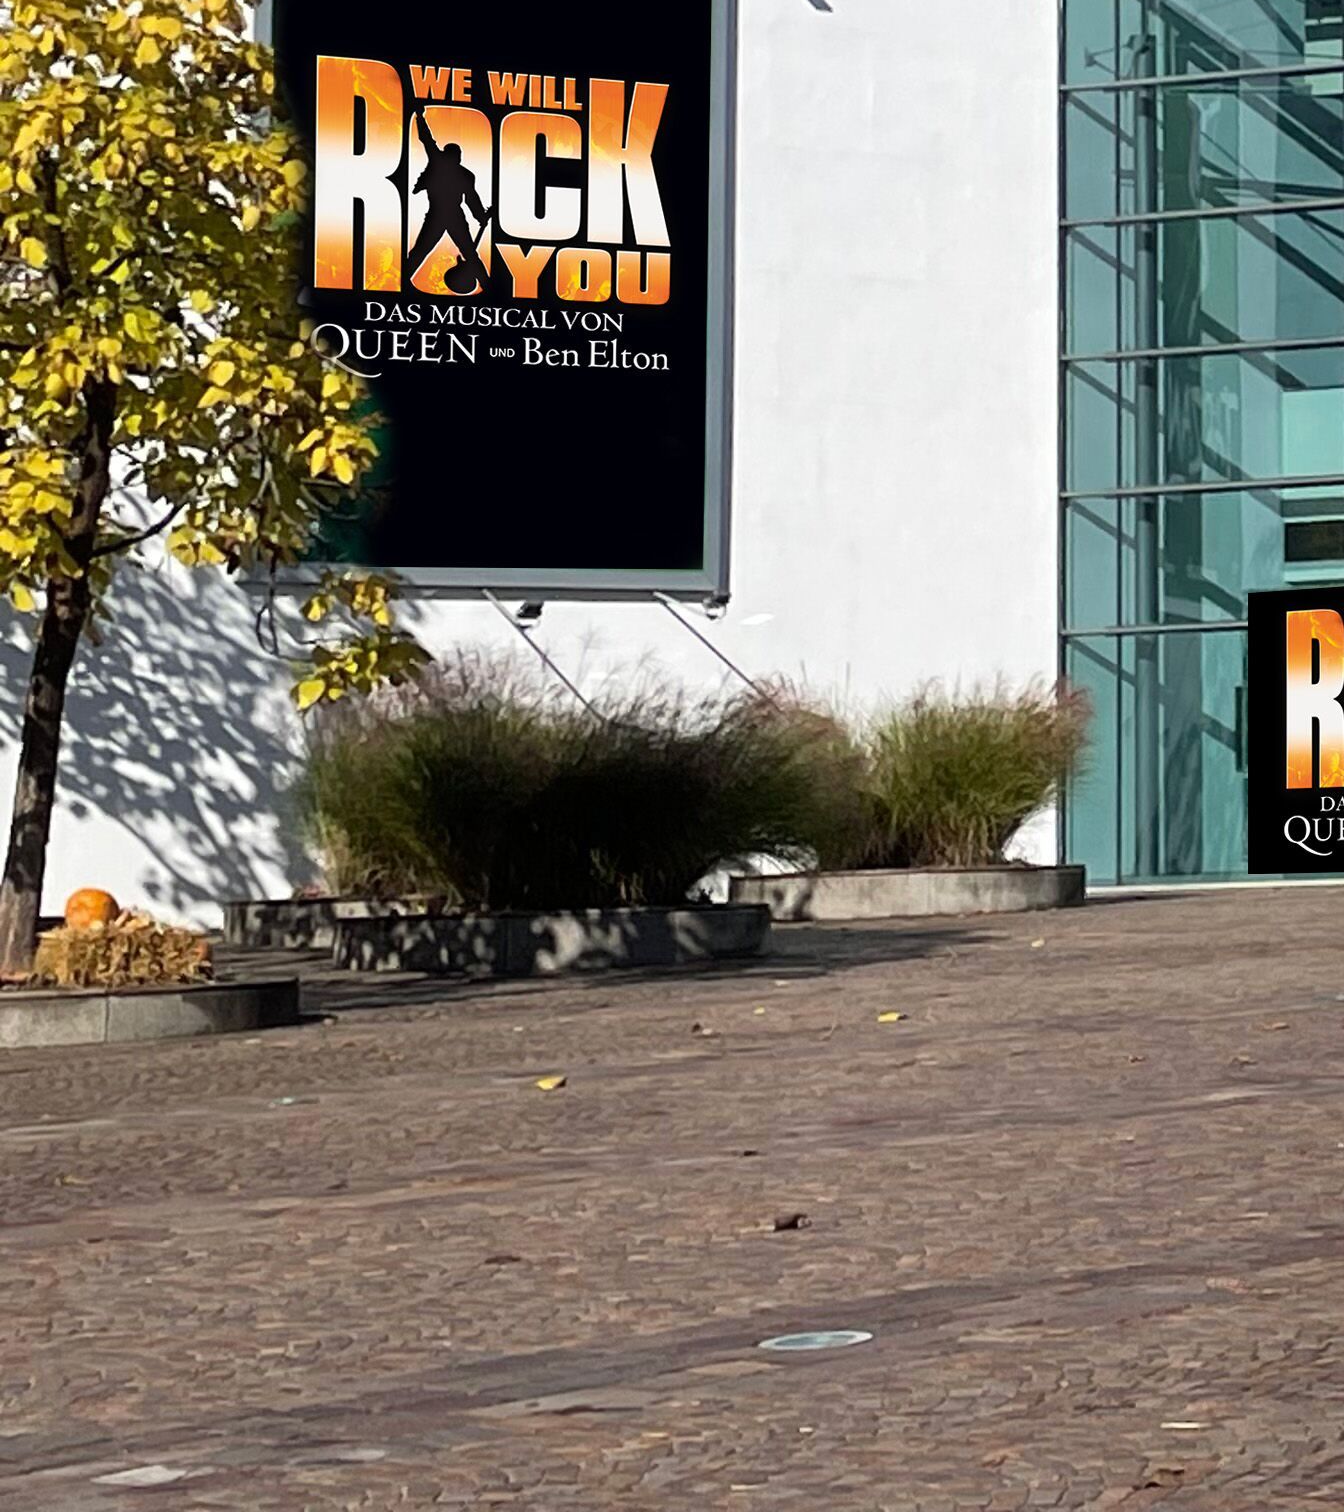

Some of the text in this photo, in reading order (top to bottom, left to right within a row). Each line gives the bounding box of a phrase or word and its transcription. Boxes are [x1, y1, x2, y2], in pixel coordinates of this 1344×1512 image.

[409, 64, 583, 111] WE WILL
[314, 54, 671, 296] ROCK
[494, 243, 671, 305] YOU
[364, 301, 624, 333] DAS MUSICAL VON
[310, 323, 670, 378] QUEEN UND Ben Elton
